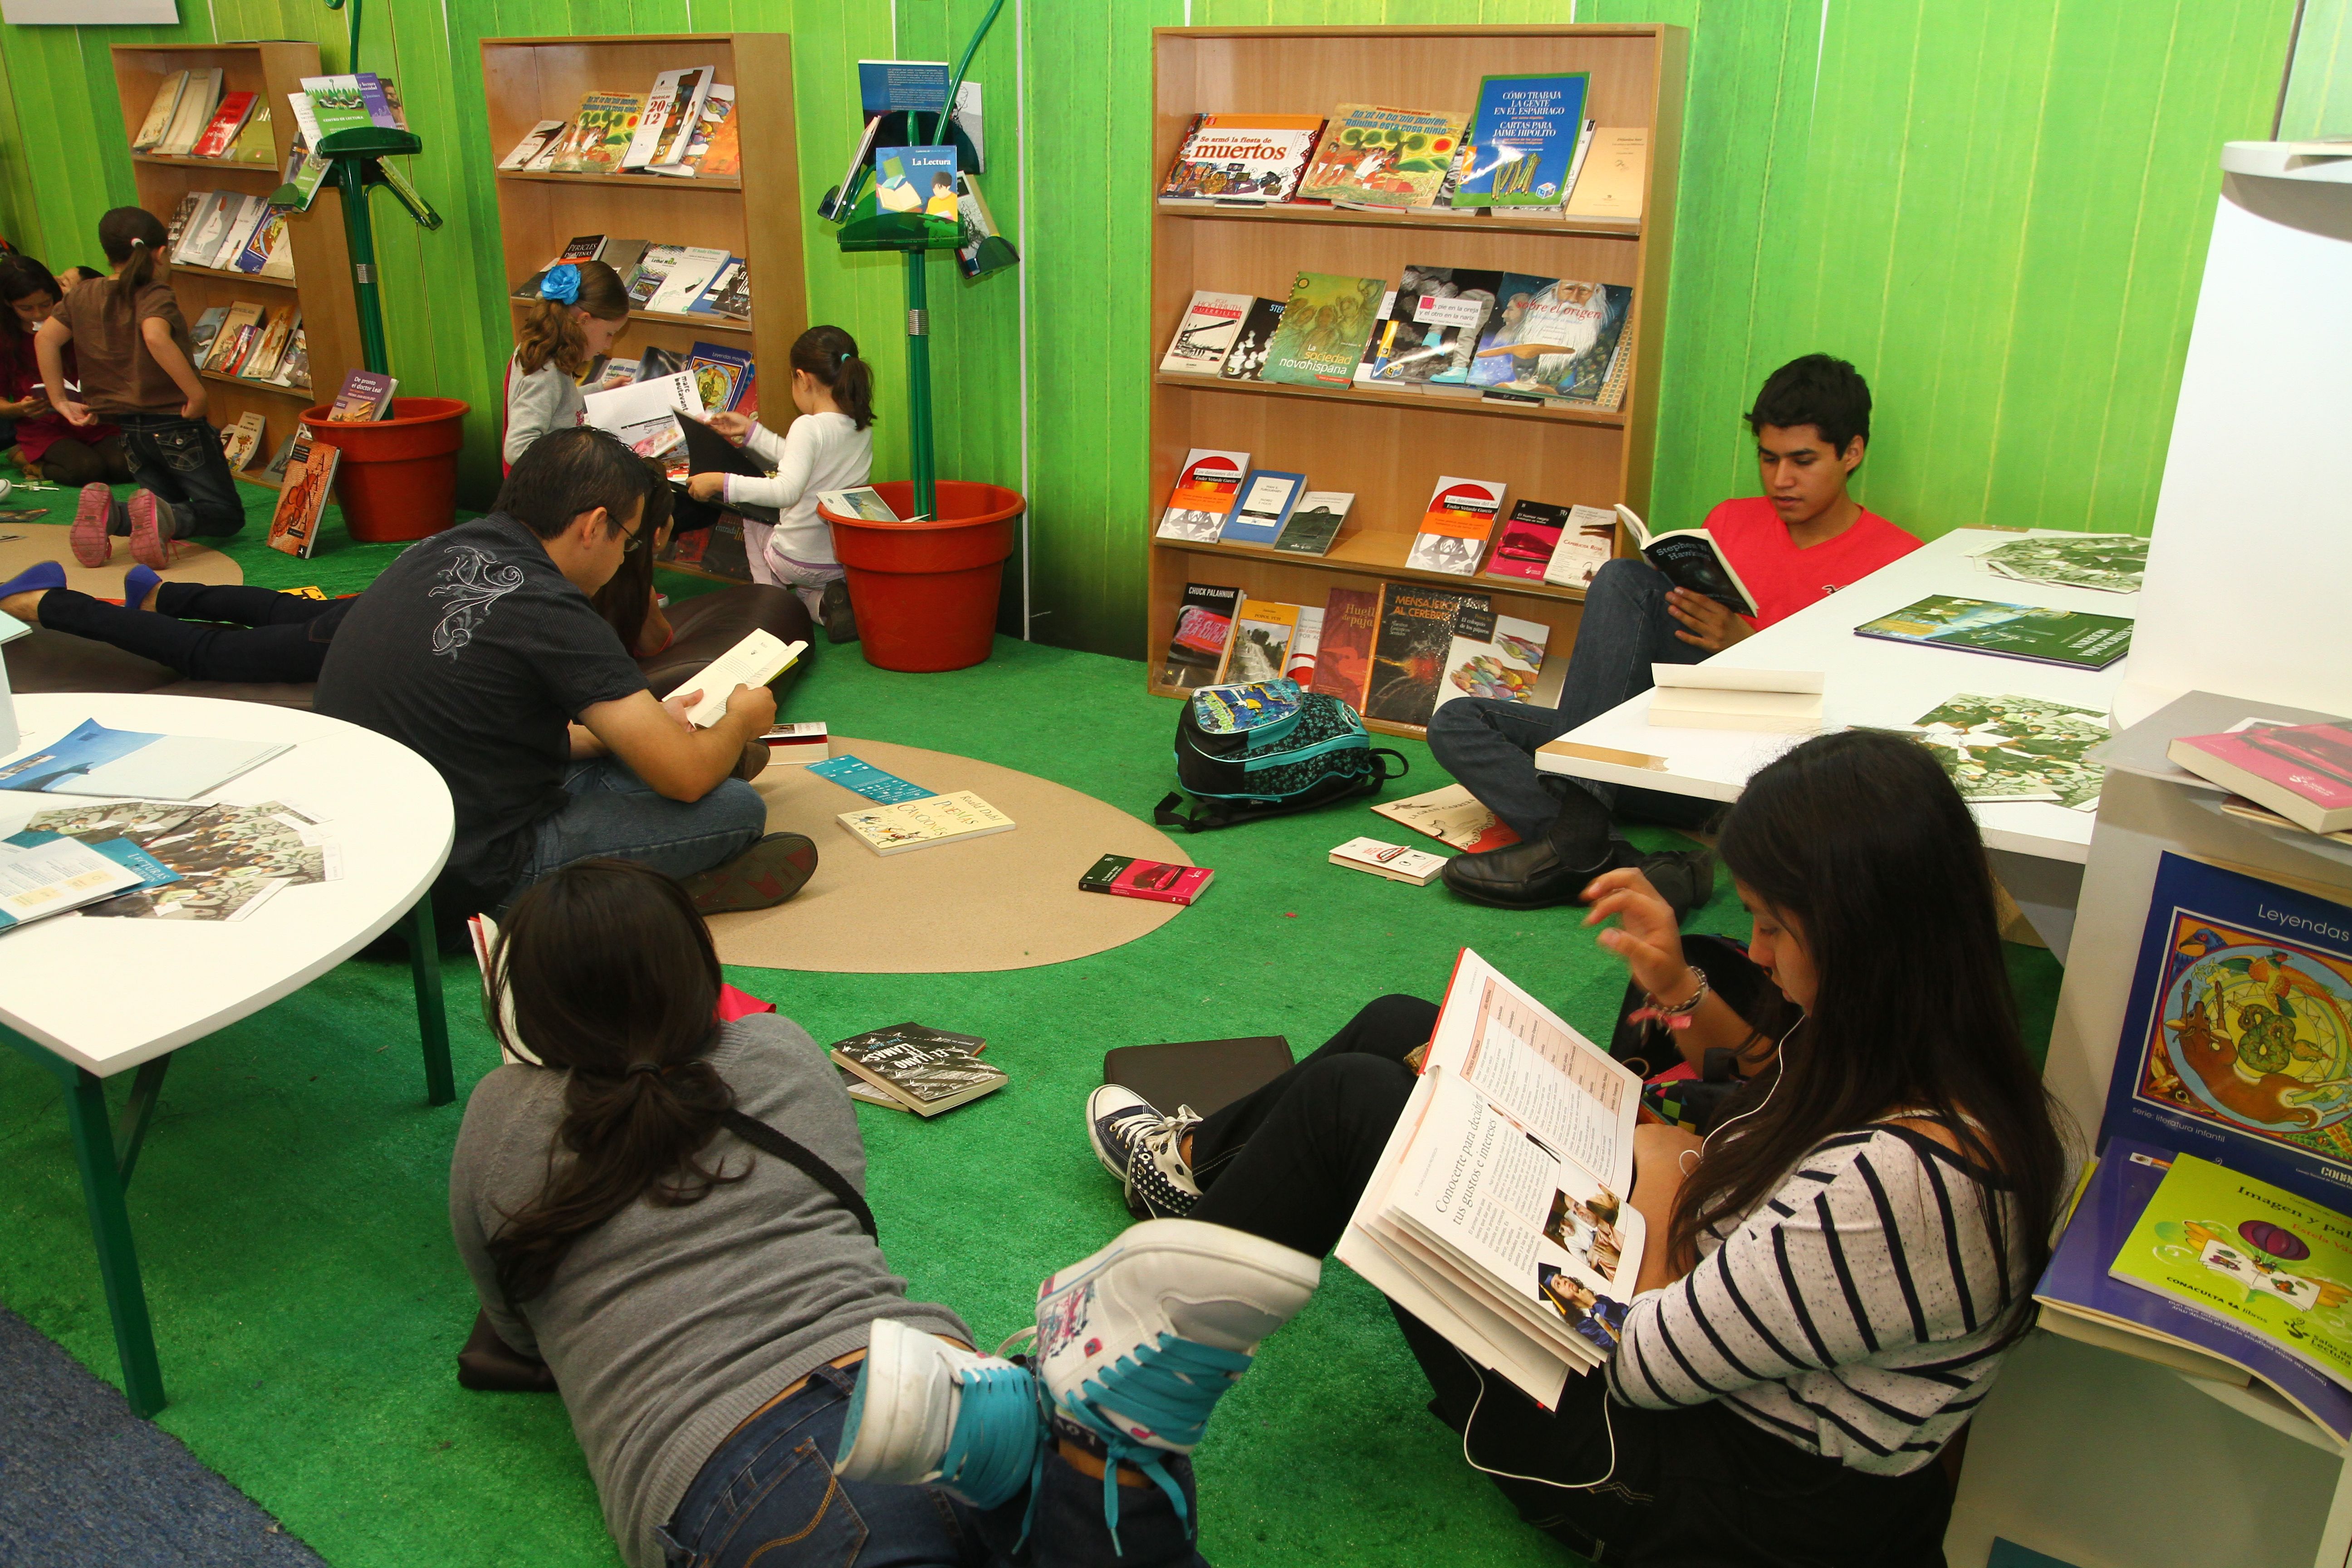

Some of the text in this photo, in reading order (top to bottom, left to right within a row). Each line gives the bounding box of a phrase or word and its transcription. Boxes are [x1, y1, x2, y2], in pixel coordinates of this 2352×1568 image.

[1503, 91, 1561, 100] CÓMO TRABAJA
[1524, 99, 1550, 108] GENTE
[648, 100, 666, 113] 20
[643, 113, 661, 125] 12
[1493, 127, 1556, 137] JAIME HIPÓLITO
[1192, 143, 1287, 160] muertos
[1193, 307, 1240, 317] GUERRILLAS
[1197, 301, 1241, 311] HOCHHUTH
[1424, 298, 1436, 309] Un
[1516, 299, 1547, 312] sobre
[1550, 304, 1562, 314] el
[1563, 307, 1602, 321] origen
[1279, 358, 1347, 374] novohispana
[1304, 352, 1352, 364] sociedad
[681, 376, 690, 392] marc
[674, 377, 689, 412] boutavant
[1656, 542, 1698, 556] Stephen
[1189, 587, 1235, 598] CHUCK PALAHNIUK
[1345, 603, 1376, 617] Huell
[1393, 606, 1451, 622] AL CEREBRO
[1473, 626, 1490, 634] pájaros
[2068, 628, 2114, 648] MODERNA
[1203, 695, 1234, 731] PLATYPUS
[932, 800, 979, 825] POEMAS
[960, 795, 1003, 821] Roald Dahl
[1417, 807, 1441, 816] GRAN
[1441, 798, 1477, 811] CARRERA
[897, 804, 948, 836] CANCIONES
[127, 853, 171, 881] LECTURAS
[2258, 903, 2350, 942] Leyendas
[866, 1043, 916, 1061] LLAMAS
[894, 1048, 950, 1068] EL LLANO
[1465, 1039, 1480, 1076] INTERESES PROFESIONALES
[2132, 1107, 2225, 1142] serie: literatura infantil
[1436, 1101, 1483, 1212] Conocerte para decidir
[1453, 1206, 1465, 1225] tus
[1462, 1169, 1480, 1207] gustos
[1476, 1119, 1496, 1159] intereses
[2237, 1186, 2302, 1217] Imagen
[1488, 1207, 1498, 1227] profesión
[1488, 1231, 1497, 1248] consiste
[1497, 1209, 1505, 1225] conocer
[1505, 1228, 1514, 1245] aquellas
[2293, 1224, 2329, 1244] Estela
[1507, 1239, 1518, 1262] actividades
[1526, 1235, 1535, 1254] dedicarte
[2166, 1276, 2268, 1324] CONACULTA libros
[2311, 1339, 2351, 1367] Lectura
[2313, 1335, 2352, 1358] Salas de
